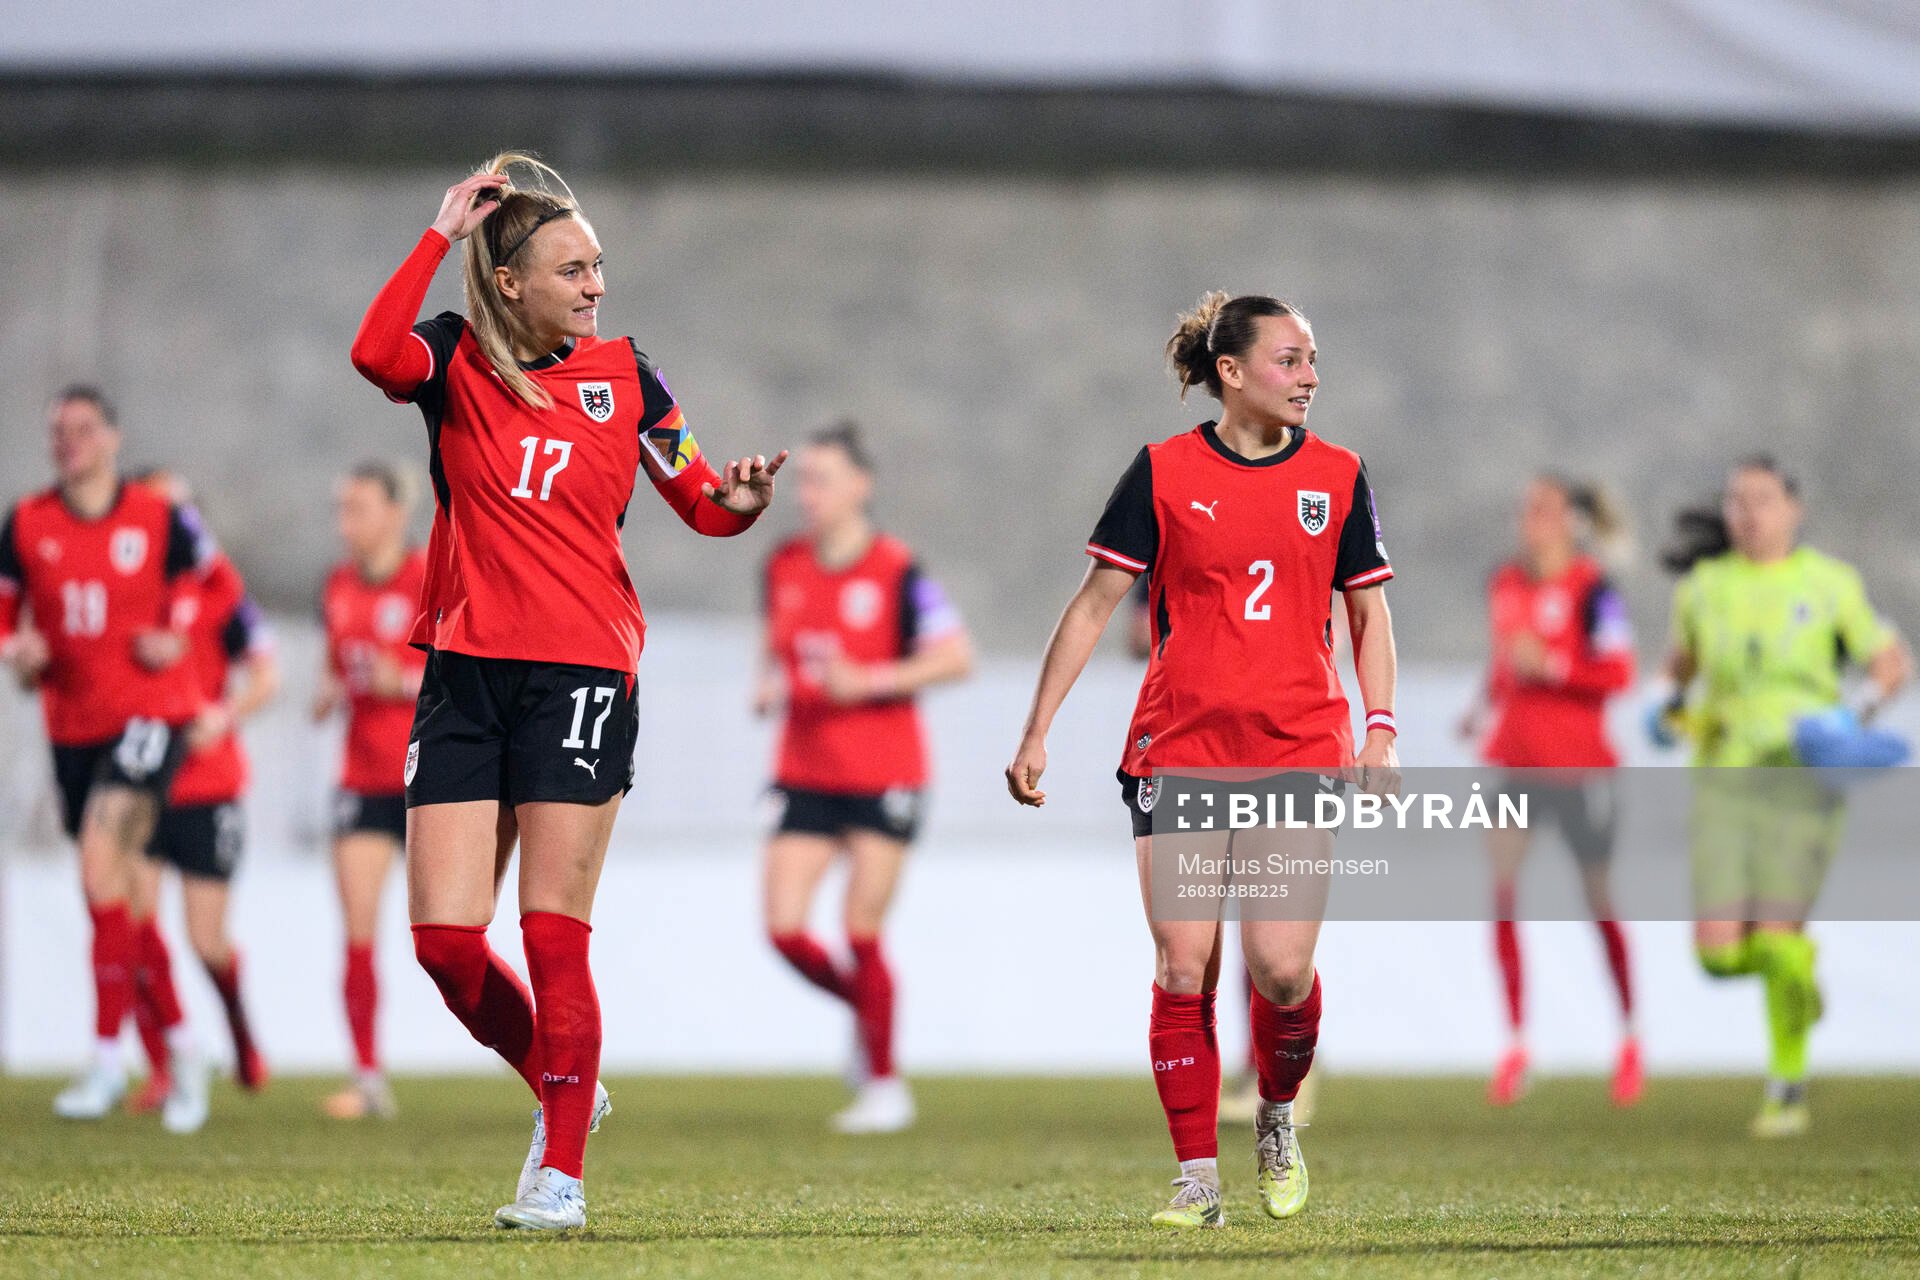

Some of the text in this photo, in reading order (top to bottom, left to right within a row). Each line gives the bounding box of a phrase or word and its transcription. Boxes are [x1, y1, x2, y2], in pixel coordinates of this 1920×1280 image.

[510, 435, 573, 502] 17
[1243, 559, 1275, 621] 2
[562, 686, 616, 750] 17
[541, 1071, 580, 1084] ÖFB
[1154, 1056, 1196, 1072] ÖFB
